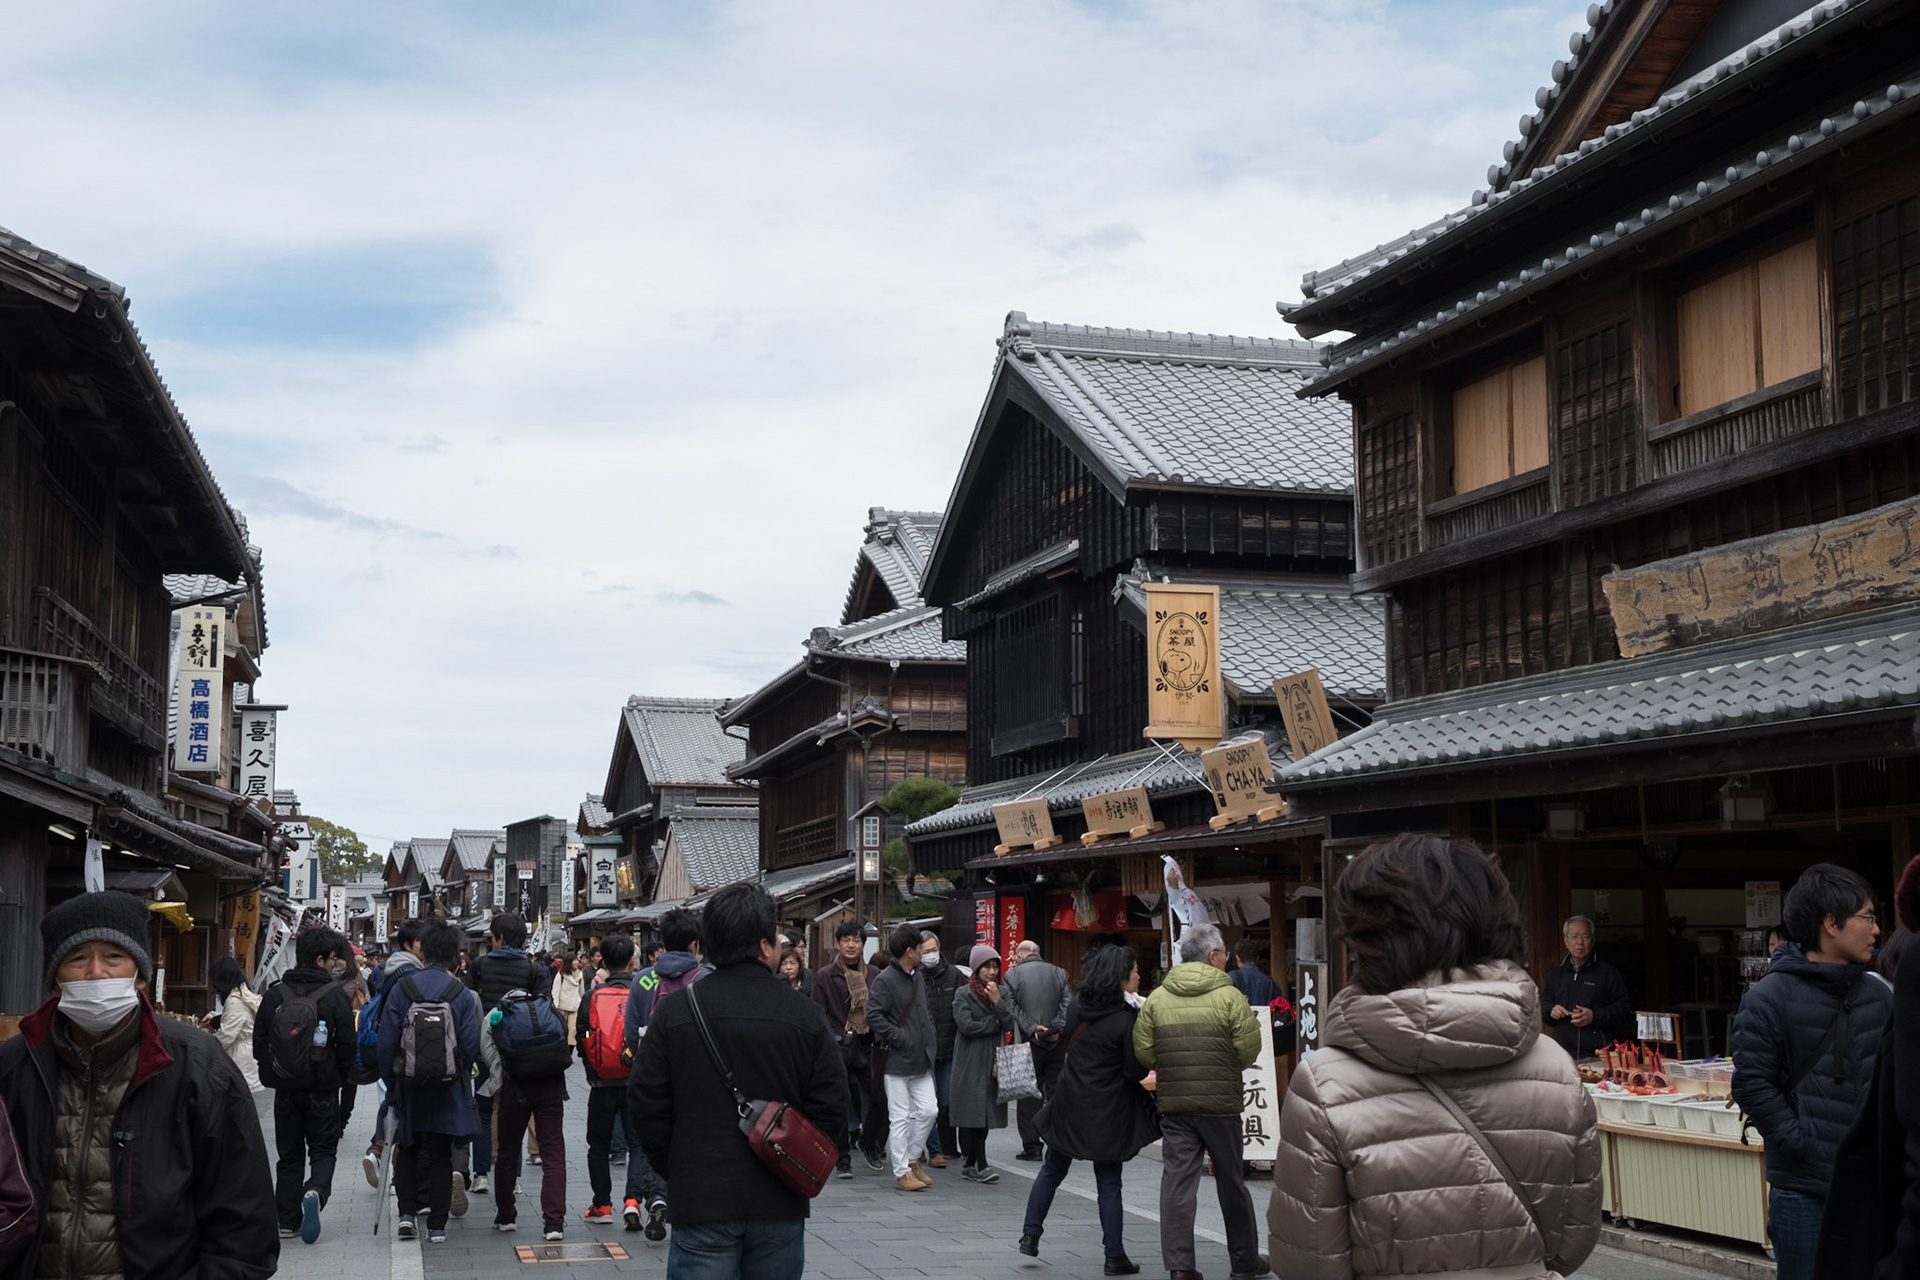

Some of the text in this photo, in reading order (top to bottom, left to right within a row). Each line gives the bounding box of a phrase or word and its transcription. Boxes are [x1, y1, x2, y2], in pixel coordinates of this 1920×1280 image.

[1168, 637, 1195, 647] 茶屋
[1169, 628, 1194, 636] SNOOPY
[1175, 692, 1194, 700] 伊勢
[187, 678, 211, 763] 高橋酒店
[244, 720, 271, 797] 喜久屋
[1226, 747, 1252, 766] SNOOPY
[593, 857, 615, 895] 白鷹
[471, 881, 479, 910] ラーメン
[1243, 1064, 1271, 1147] 玩具
